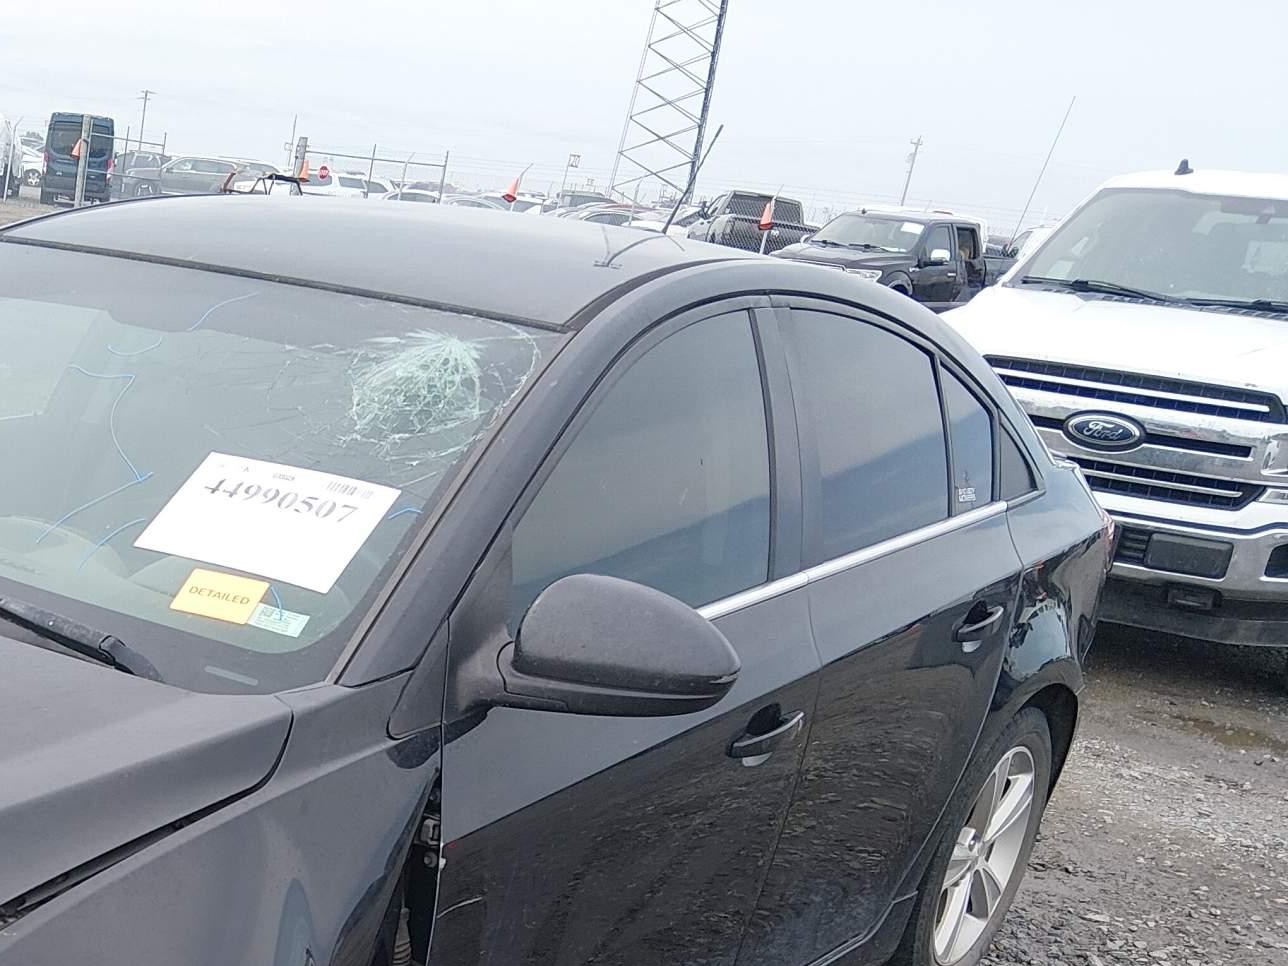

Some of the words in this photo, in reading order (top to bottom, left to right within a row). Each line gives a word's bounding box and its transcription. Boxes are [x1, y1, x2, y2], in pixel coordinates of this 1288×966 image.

[1083, 421, 1124, 441] Ford
[204, 478, 359, 522] 44990507
[189, 586, 250, 604] DETAILED
